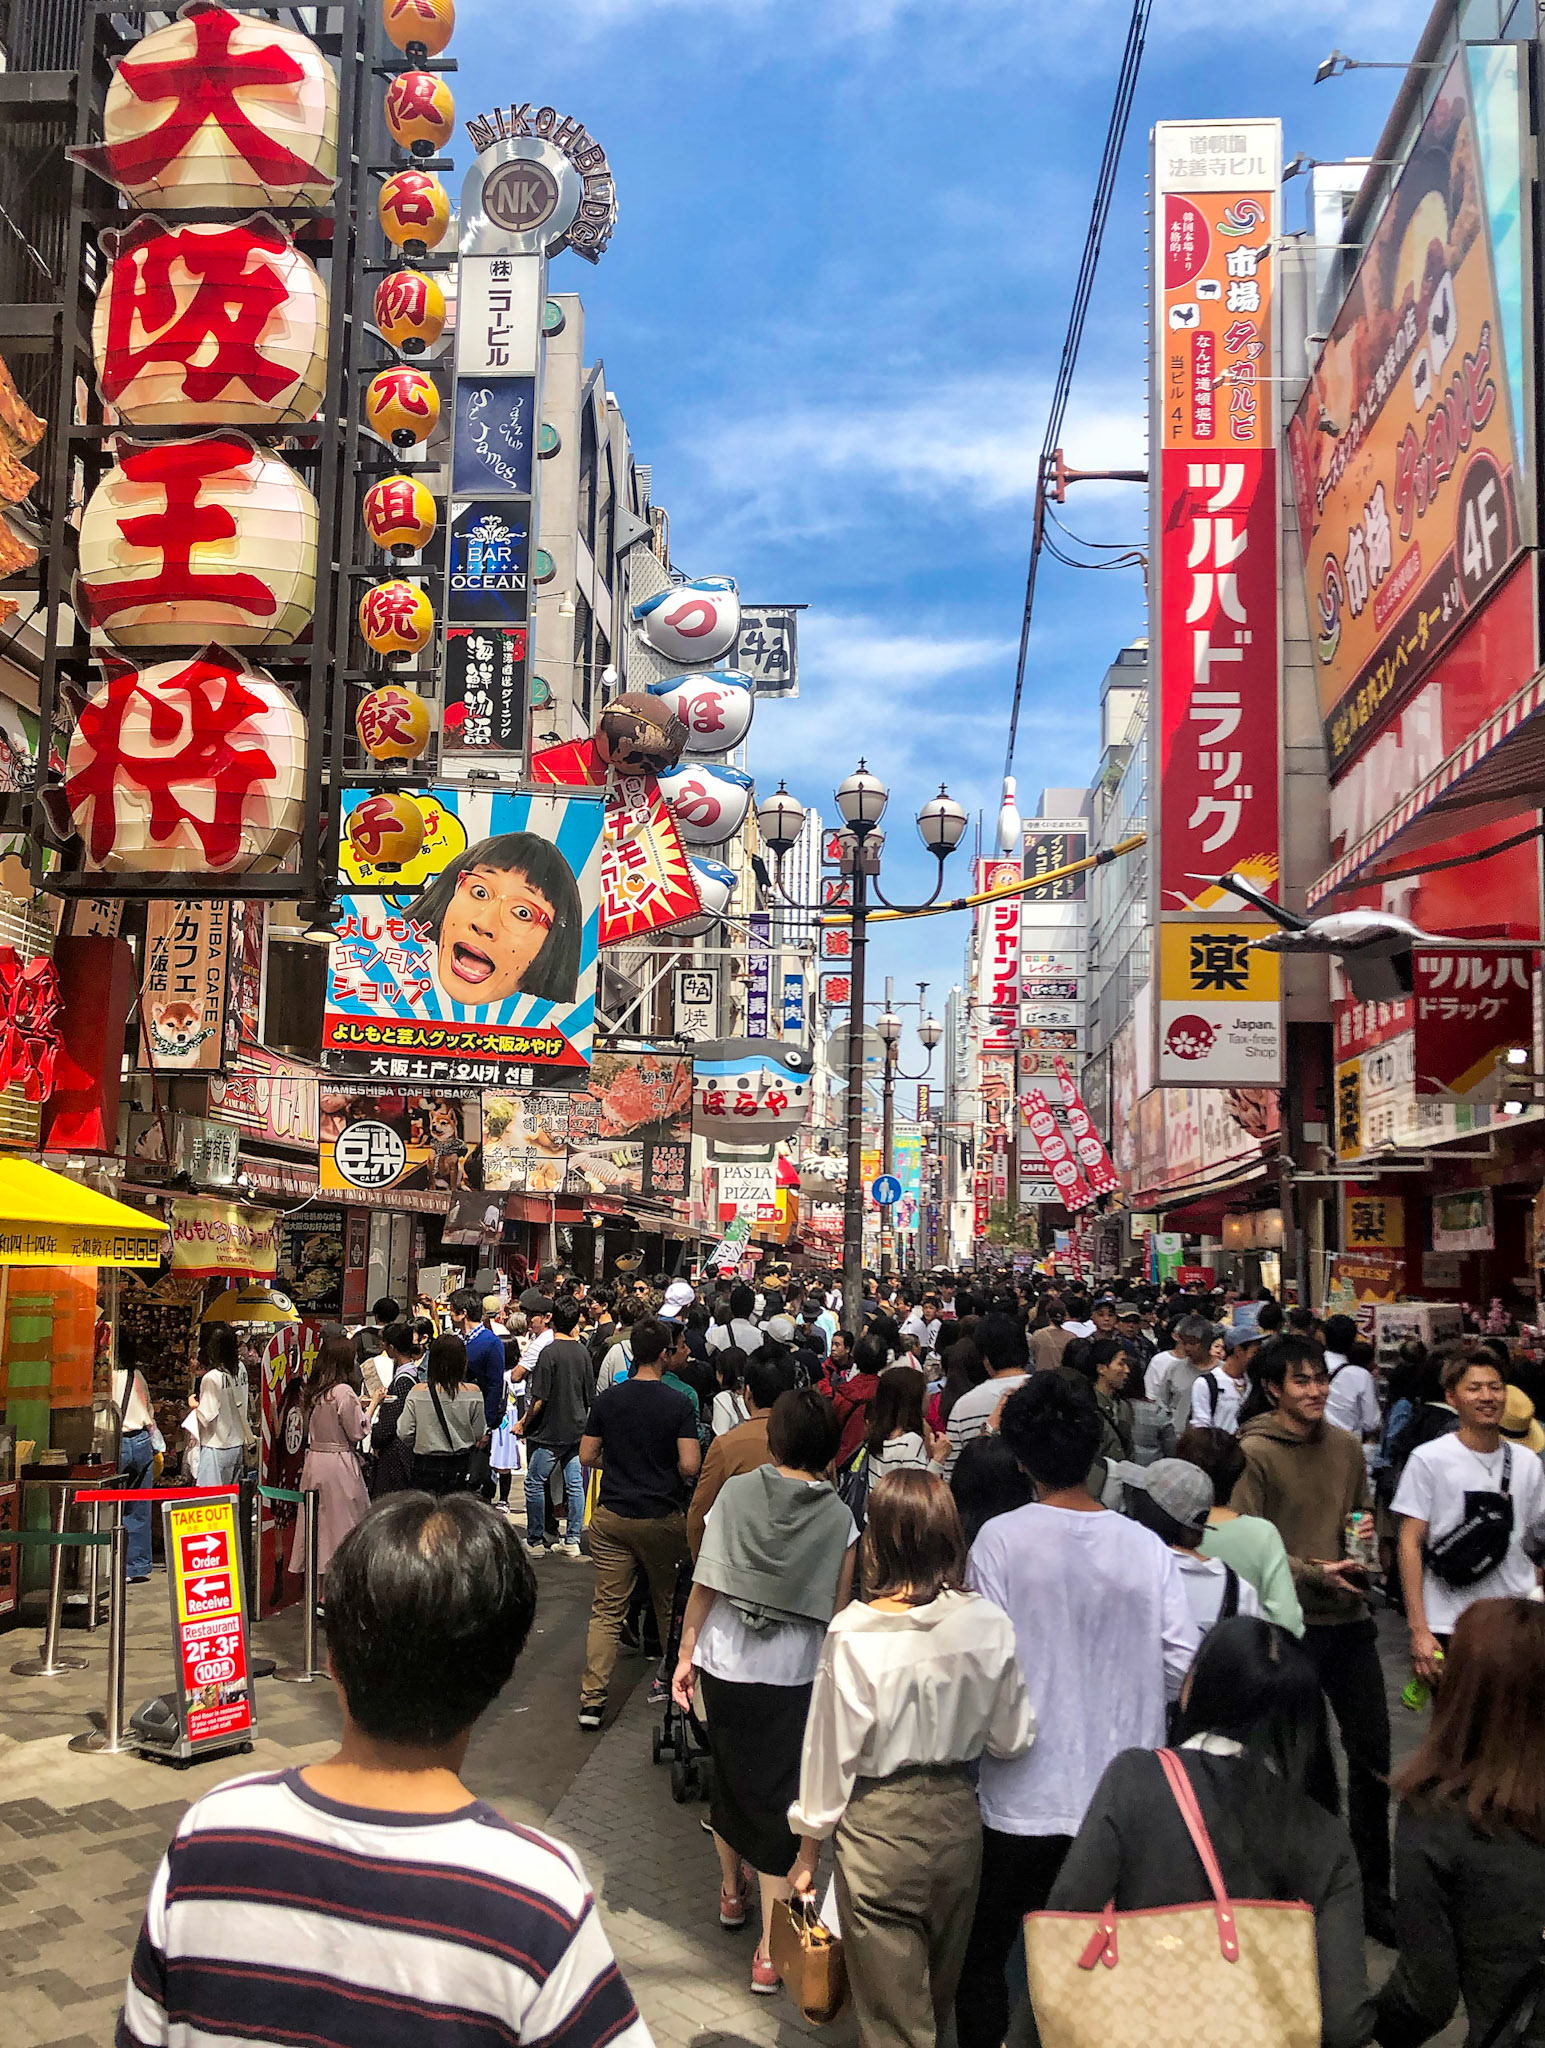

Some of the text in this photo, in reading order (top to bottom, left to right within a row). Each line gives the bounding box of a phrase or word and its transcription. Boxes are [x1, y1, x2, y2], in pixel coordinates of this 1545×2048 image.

[1190, 135, 1247, 154] 道頓堀
[1169, 157, 1266, 177] 法善寺ビル
[497, 180, 542, 214] NK
[1183, 212, 1194, 271] 韓国本場より
[1195, 335, 1212, 436] なんば道頓堀店
[44, 3, 336, 866] 大阪王将
[1463, 477, 1499, 582] 4F
[467, 547, 512, 562] BAR
[450, 574, 527, 589] OCEAN
[739, 631, 789, 674] 牛角
[1185, 463, 1253, 854] ツルハドラッグ
[463, 635, 494, 746] 海鮮物語
[1034, 845, 1048, 900] &コミク
[1050, 834, 1064, 900] インターット
[335, 914, 434, 944] よしもと
[148, 935, 169, 992] 大阪店
[334, 943, 434, 974] エンタメ
[993, 903, 1019, 1037] ジャンカラ
[1190, 933, 1249, 991] 薬
[1417, 956, 1530, 990] ツルハ
[204, 969, 221, 1023] CAFE
[331, 974, 433, 1007] ショップ
[784, 982, 803, 1021] 焼肉
[1418, 996, 1509, 1021] ドラッグ
[332, 1022, 564, 1057] よしもと芸人グッズ・大阪みやげ
[1227, 1033, 1277, 1045] Tax-free
[1232, 1018, 1277, 1031] Japan.
[1245, 1046, 1277, 1059] Shop
[457, 1064, 500, 1085] 오사카
[504, 1066, 534, 1086] 선물
[322, 1084, 477, 1100] MAMESHIBA CAFE OSAKA
[693, 1090, 789, 1117] ぼらや
[340, 1131, 402, 1176] 豆柴
[359, 1175, 380, 1183] CAFE
[723, 1167, 772, 1179] PASTA
[725, 1186, 772, 1200] PIZZA
[757, 1208, 774, 1218] 2F
[173, 1507, 229, 1526] TAKE OUT
[192, 1554, 221, 1570] Order
[188, 1595, 230, 1614] Receive
[185, 1619, 238, 1640] Restaurant
